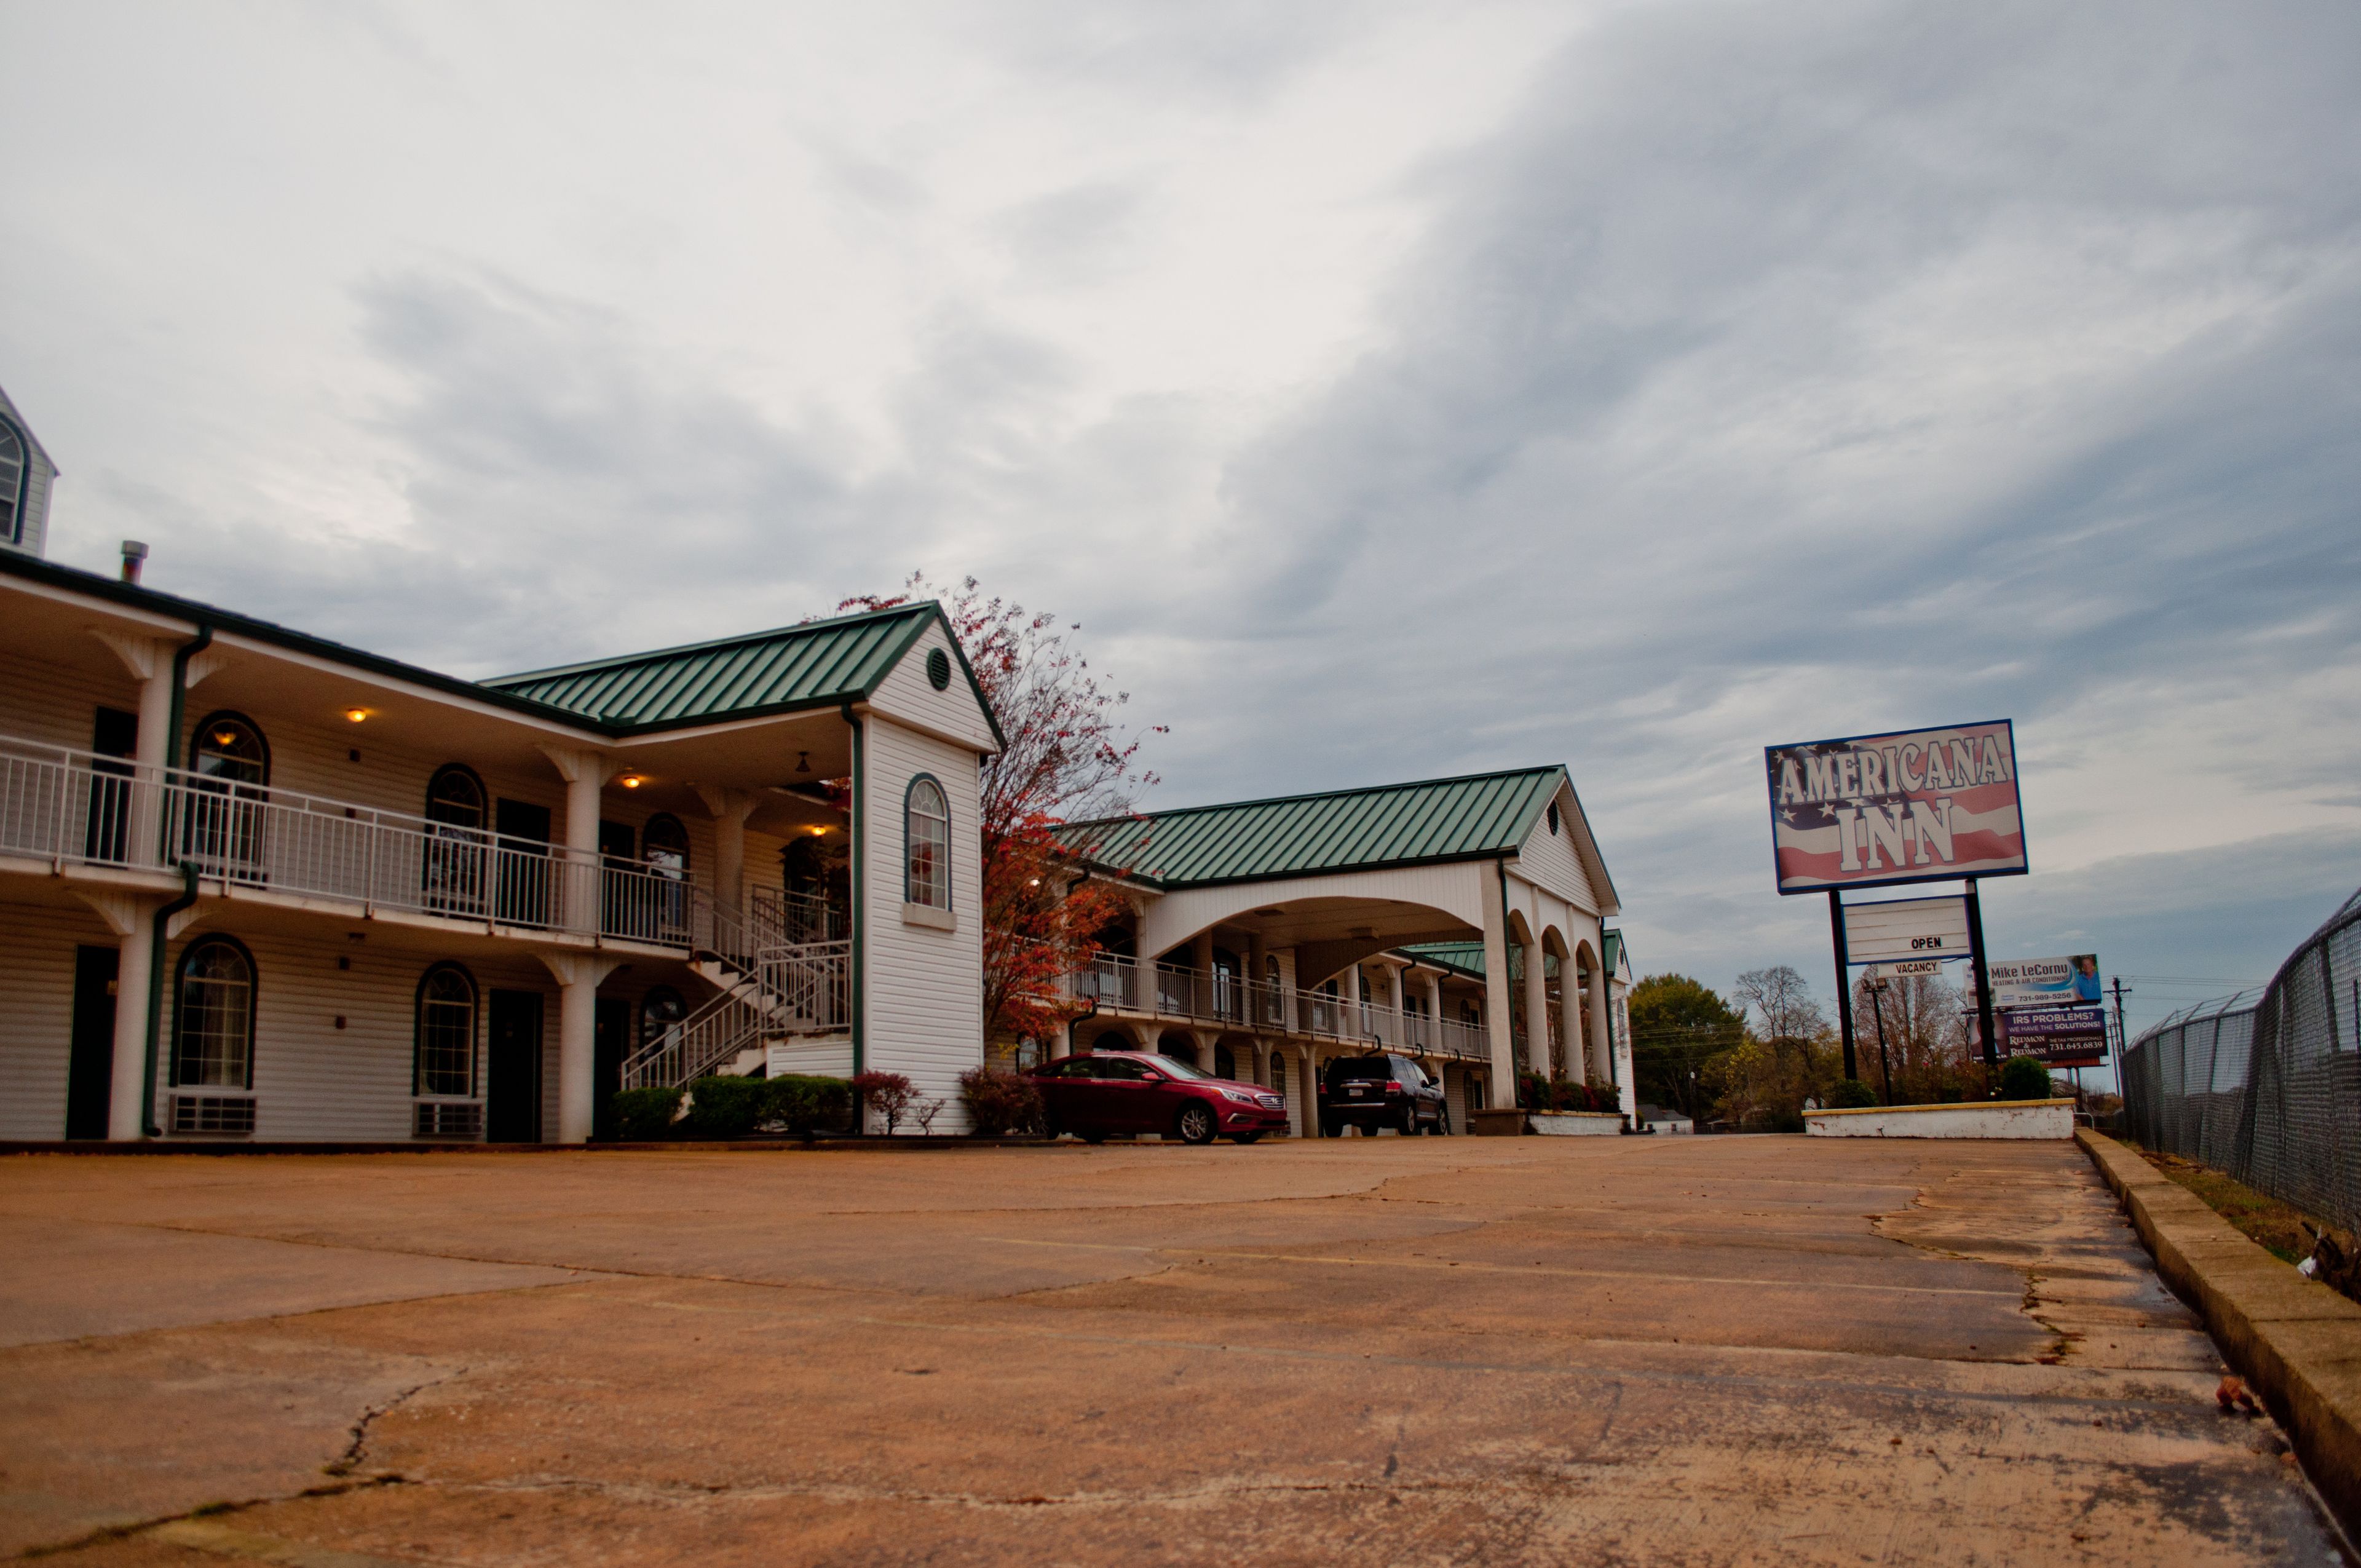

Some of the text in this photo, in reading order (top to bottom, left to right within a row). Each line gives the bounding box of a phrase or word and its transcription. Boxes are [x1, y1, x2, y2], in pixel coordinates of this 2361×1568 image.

[1777, 734, 2009, 805] AMERICANA
[1835, 797, 1955, 873] INN
[1912, 936, 1942, 949] OPEN
[1896, 962, 1937, 974] VACANCY
[1991, 964, 2068, 979] Mike LeCornu
[2032, 975, 2069, 983] CONDITIONING
[2018, 992, 2071, 1002] 731-989-5256
[2012, 1012, 2094, 1024] IRS PROBLEMS?
[2054, 1021, 2100, 1029] SOLUTIONS!
[2049, 1040, 2103, 1051] 731.645.6839
